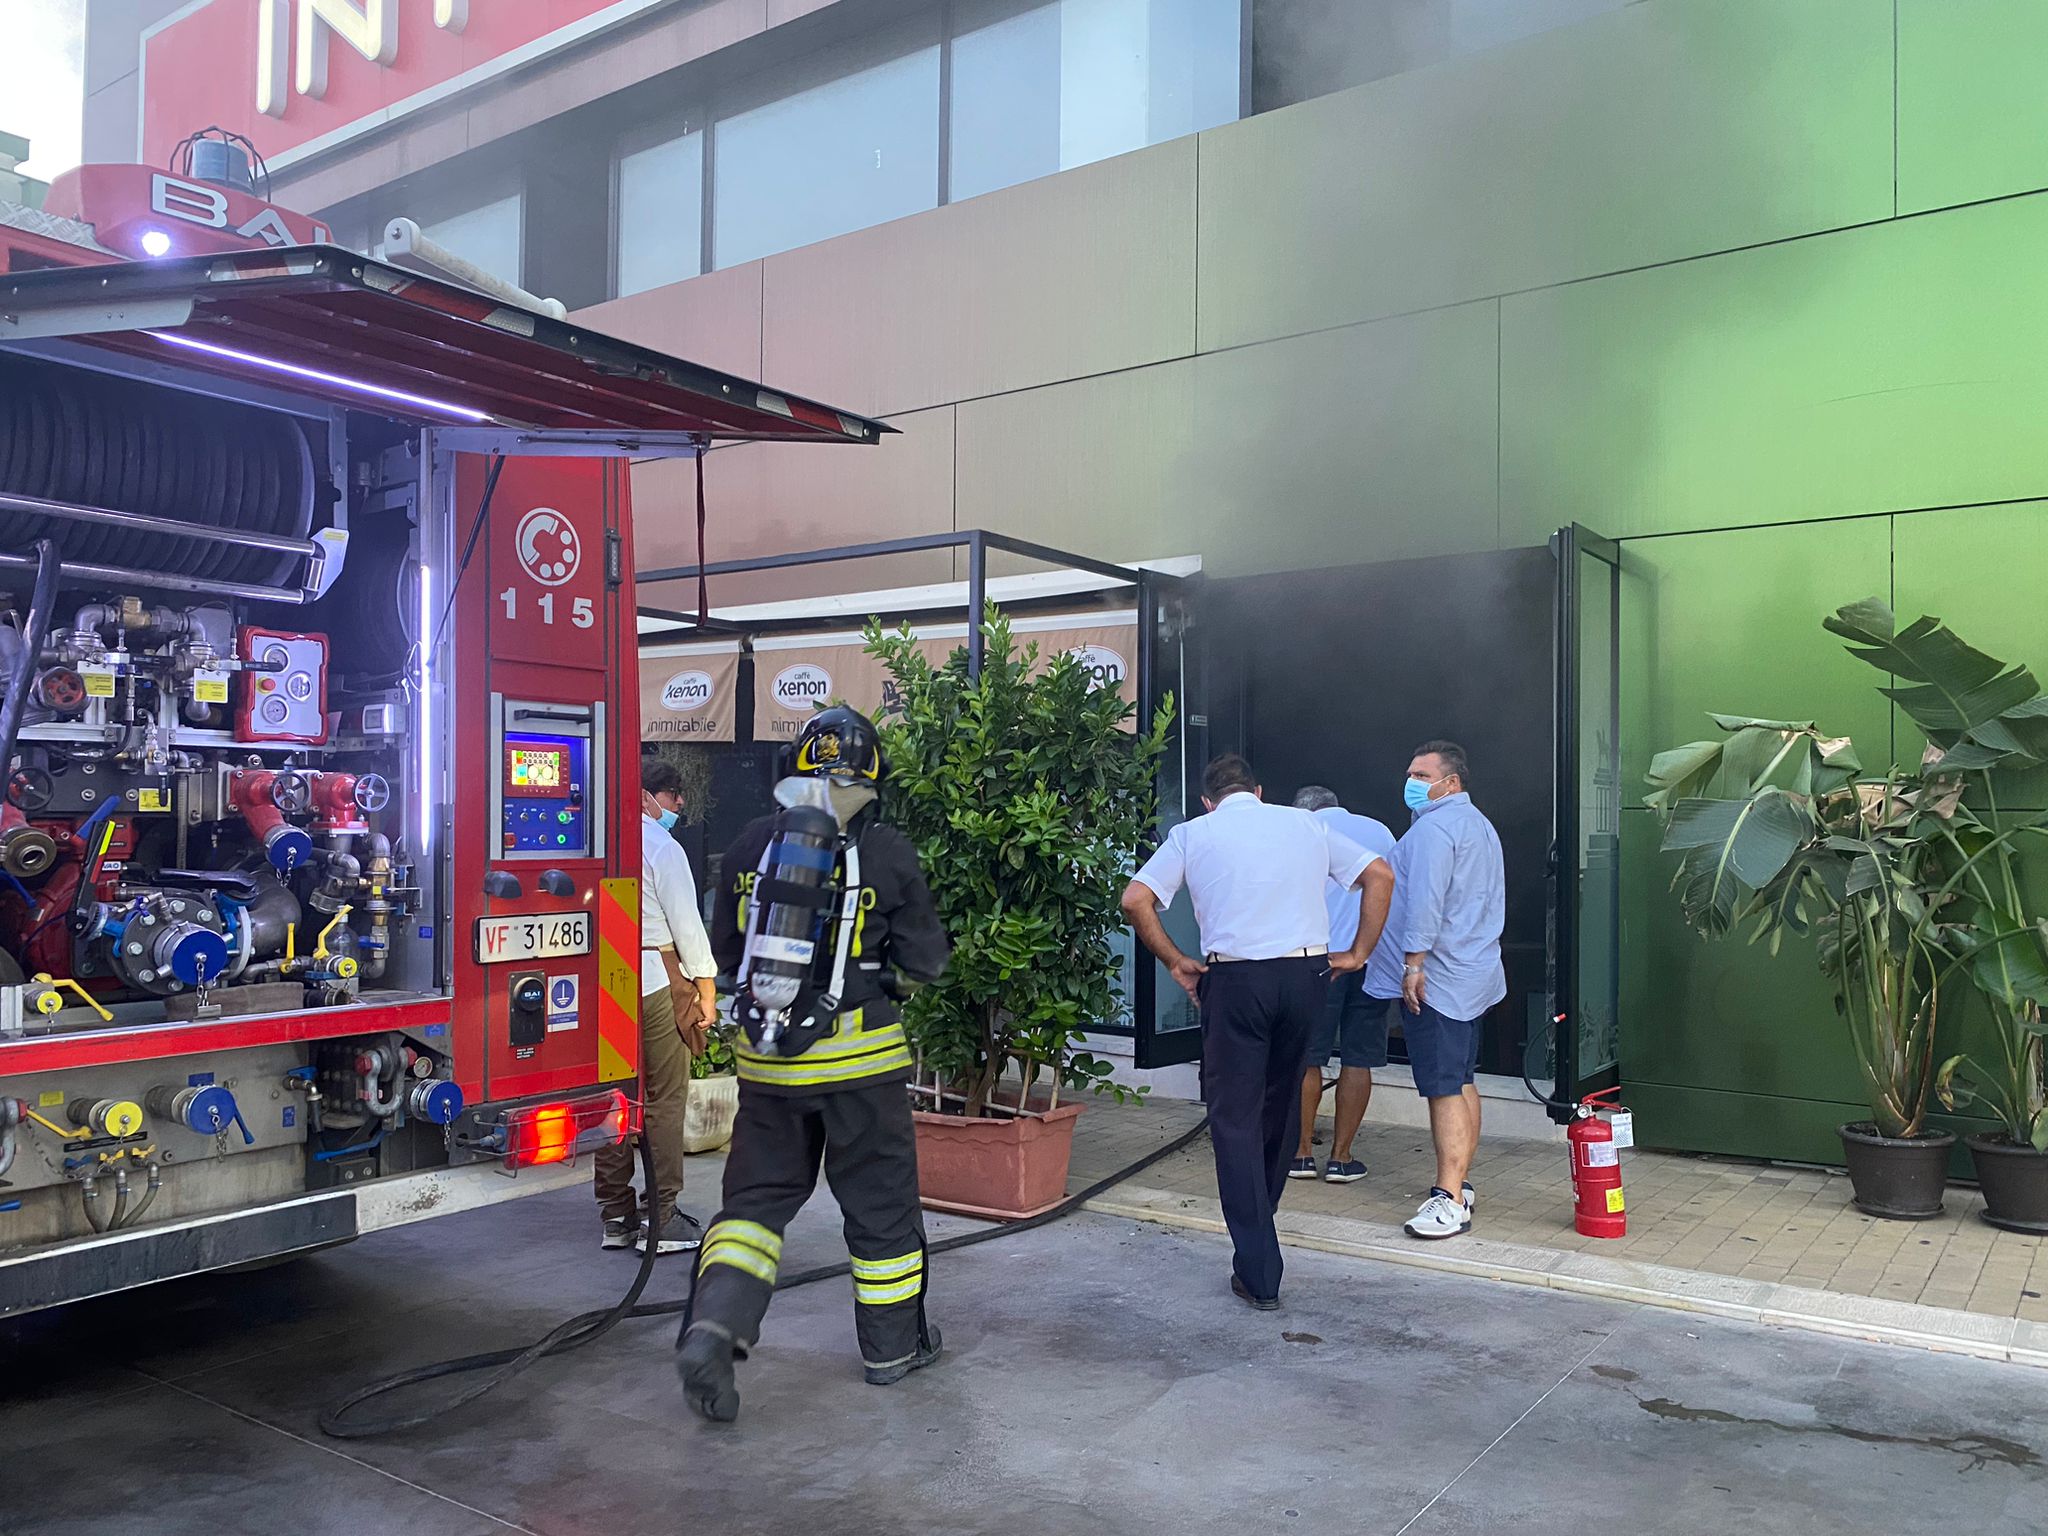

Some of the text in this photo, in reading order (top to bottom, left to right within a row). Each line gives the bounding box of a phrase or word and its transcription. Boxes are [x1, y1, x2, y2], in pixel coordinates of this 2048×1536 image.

[665, 683, 707, 699] kenon
[778, 679, 827, 696] kenon
[647, 717, 717, 733] inimitabile
[485, 920, 584, 954] VF 31486
[524, 990, 541, 998] BAI
